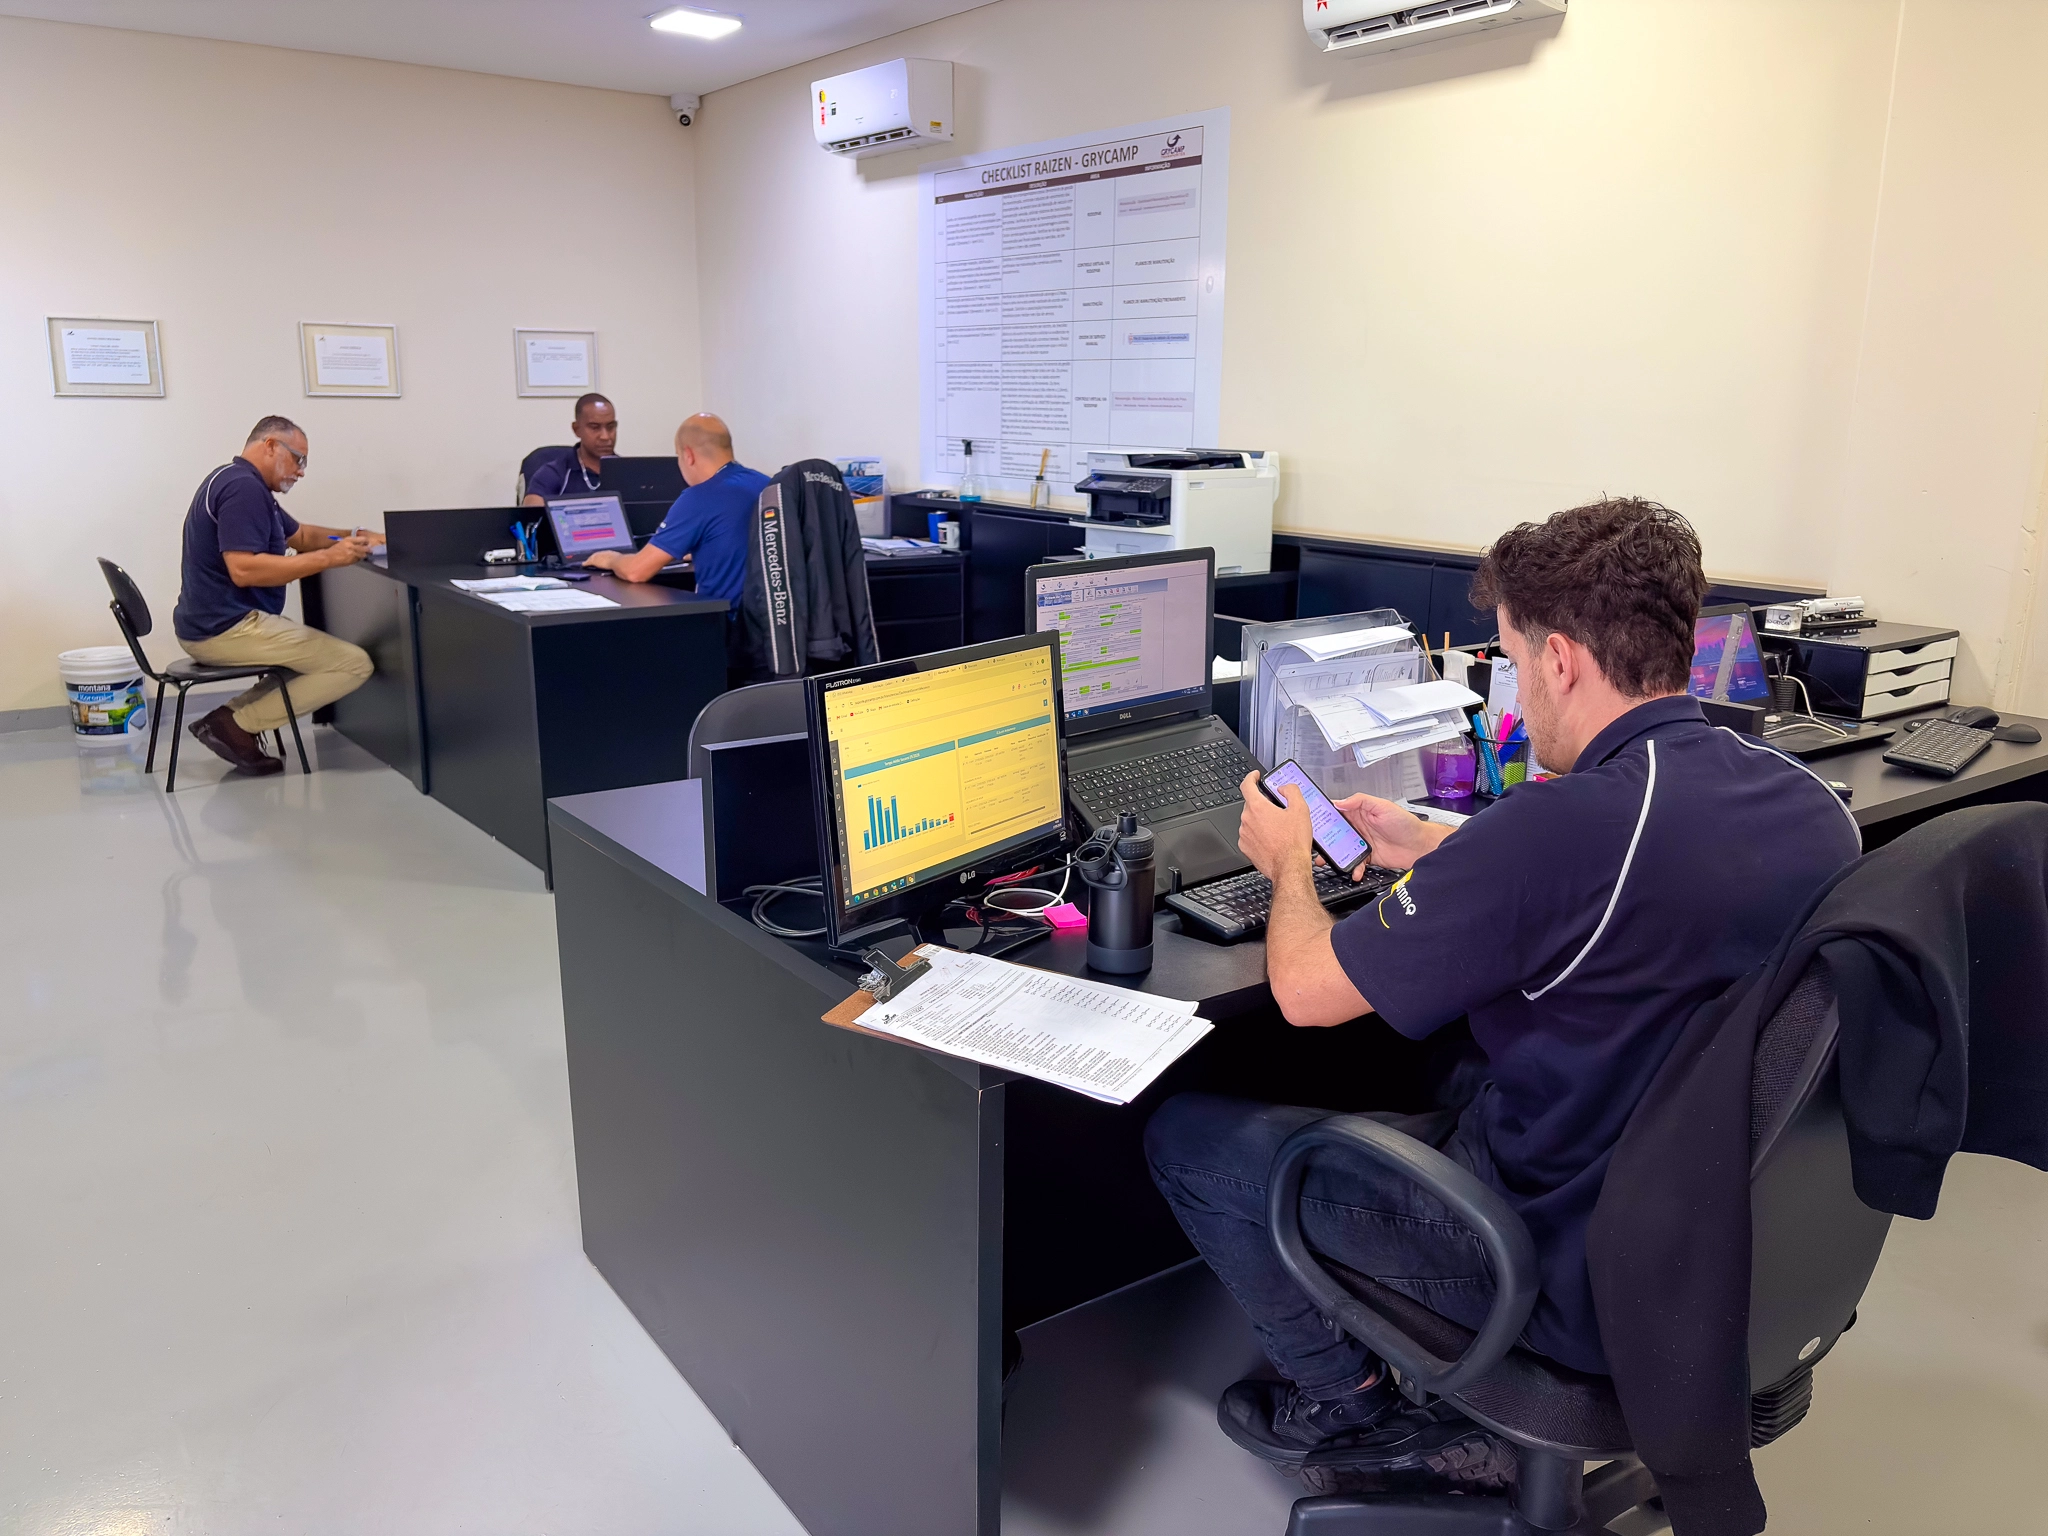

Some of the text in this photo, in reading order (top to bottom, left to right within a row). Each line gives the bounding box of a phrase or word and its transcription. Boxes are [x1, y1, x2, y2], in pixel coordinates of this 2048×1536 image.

[981, 163, 1031, 184] CHECKLIST
[1034, 156, 1072, 176] RAIZEN
[1081, 145, 1139, 168] GRYCAMP
[763, 520, 787, 626] Mercedes-Benz
[78, 684, 111, 692] montana
[825, 678, 853, 689] FLATRON
[1119, 712, 1132, 720] DELL
[967, 870, 976, 880] LG
